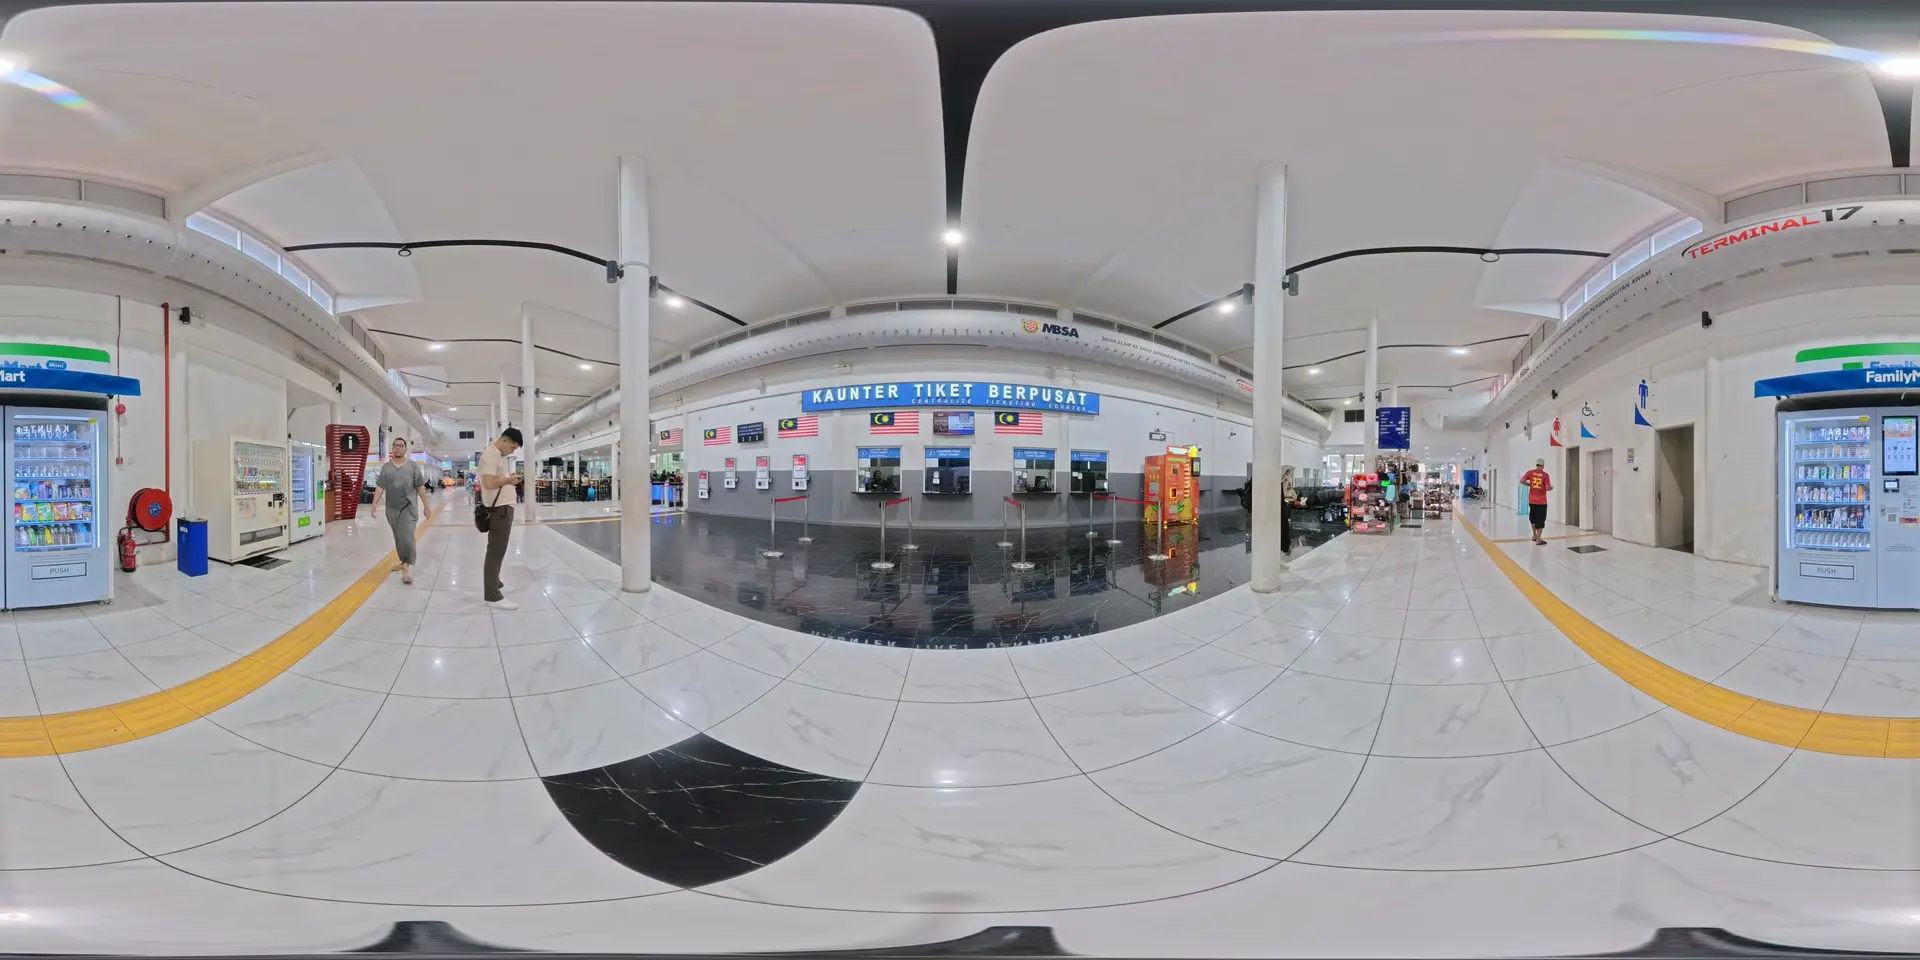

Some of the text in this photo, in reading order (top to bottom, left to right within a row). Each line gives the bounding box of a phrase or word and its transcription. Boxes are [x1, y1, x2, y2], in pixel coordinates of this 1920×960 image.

[1687, 205, 1864, 259] TERMINAL 17
[1631, 269, 1651, 285] AWAM
[1041, 323, 1079, 339] MBSA
[812, 383, 1087, 405] KAUNTER TIKET BERPUSAT
[985, 400, 1036, 408] TICKETING
[1048, 403, 1087, 413] COUNTER
[49, 567, 70, 575] PUSH
[1816, 567, 1837, 575] PUSH
